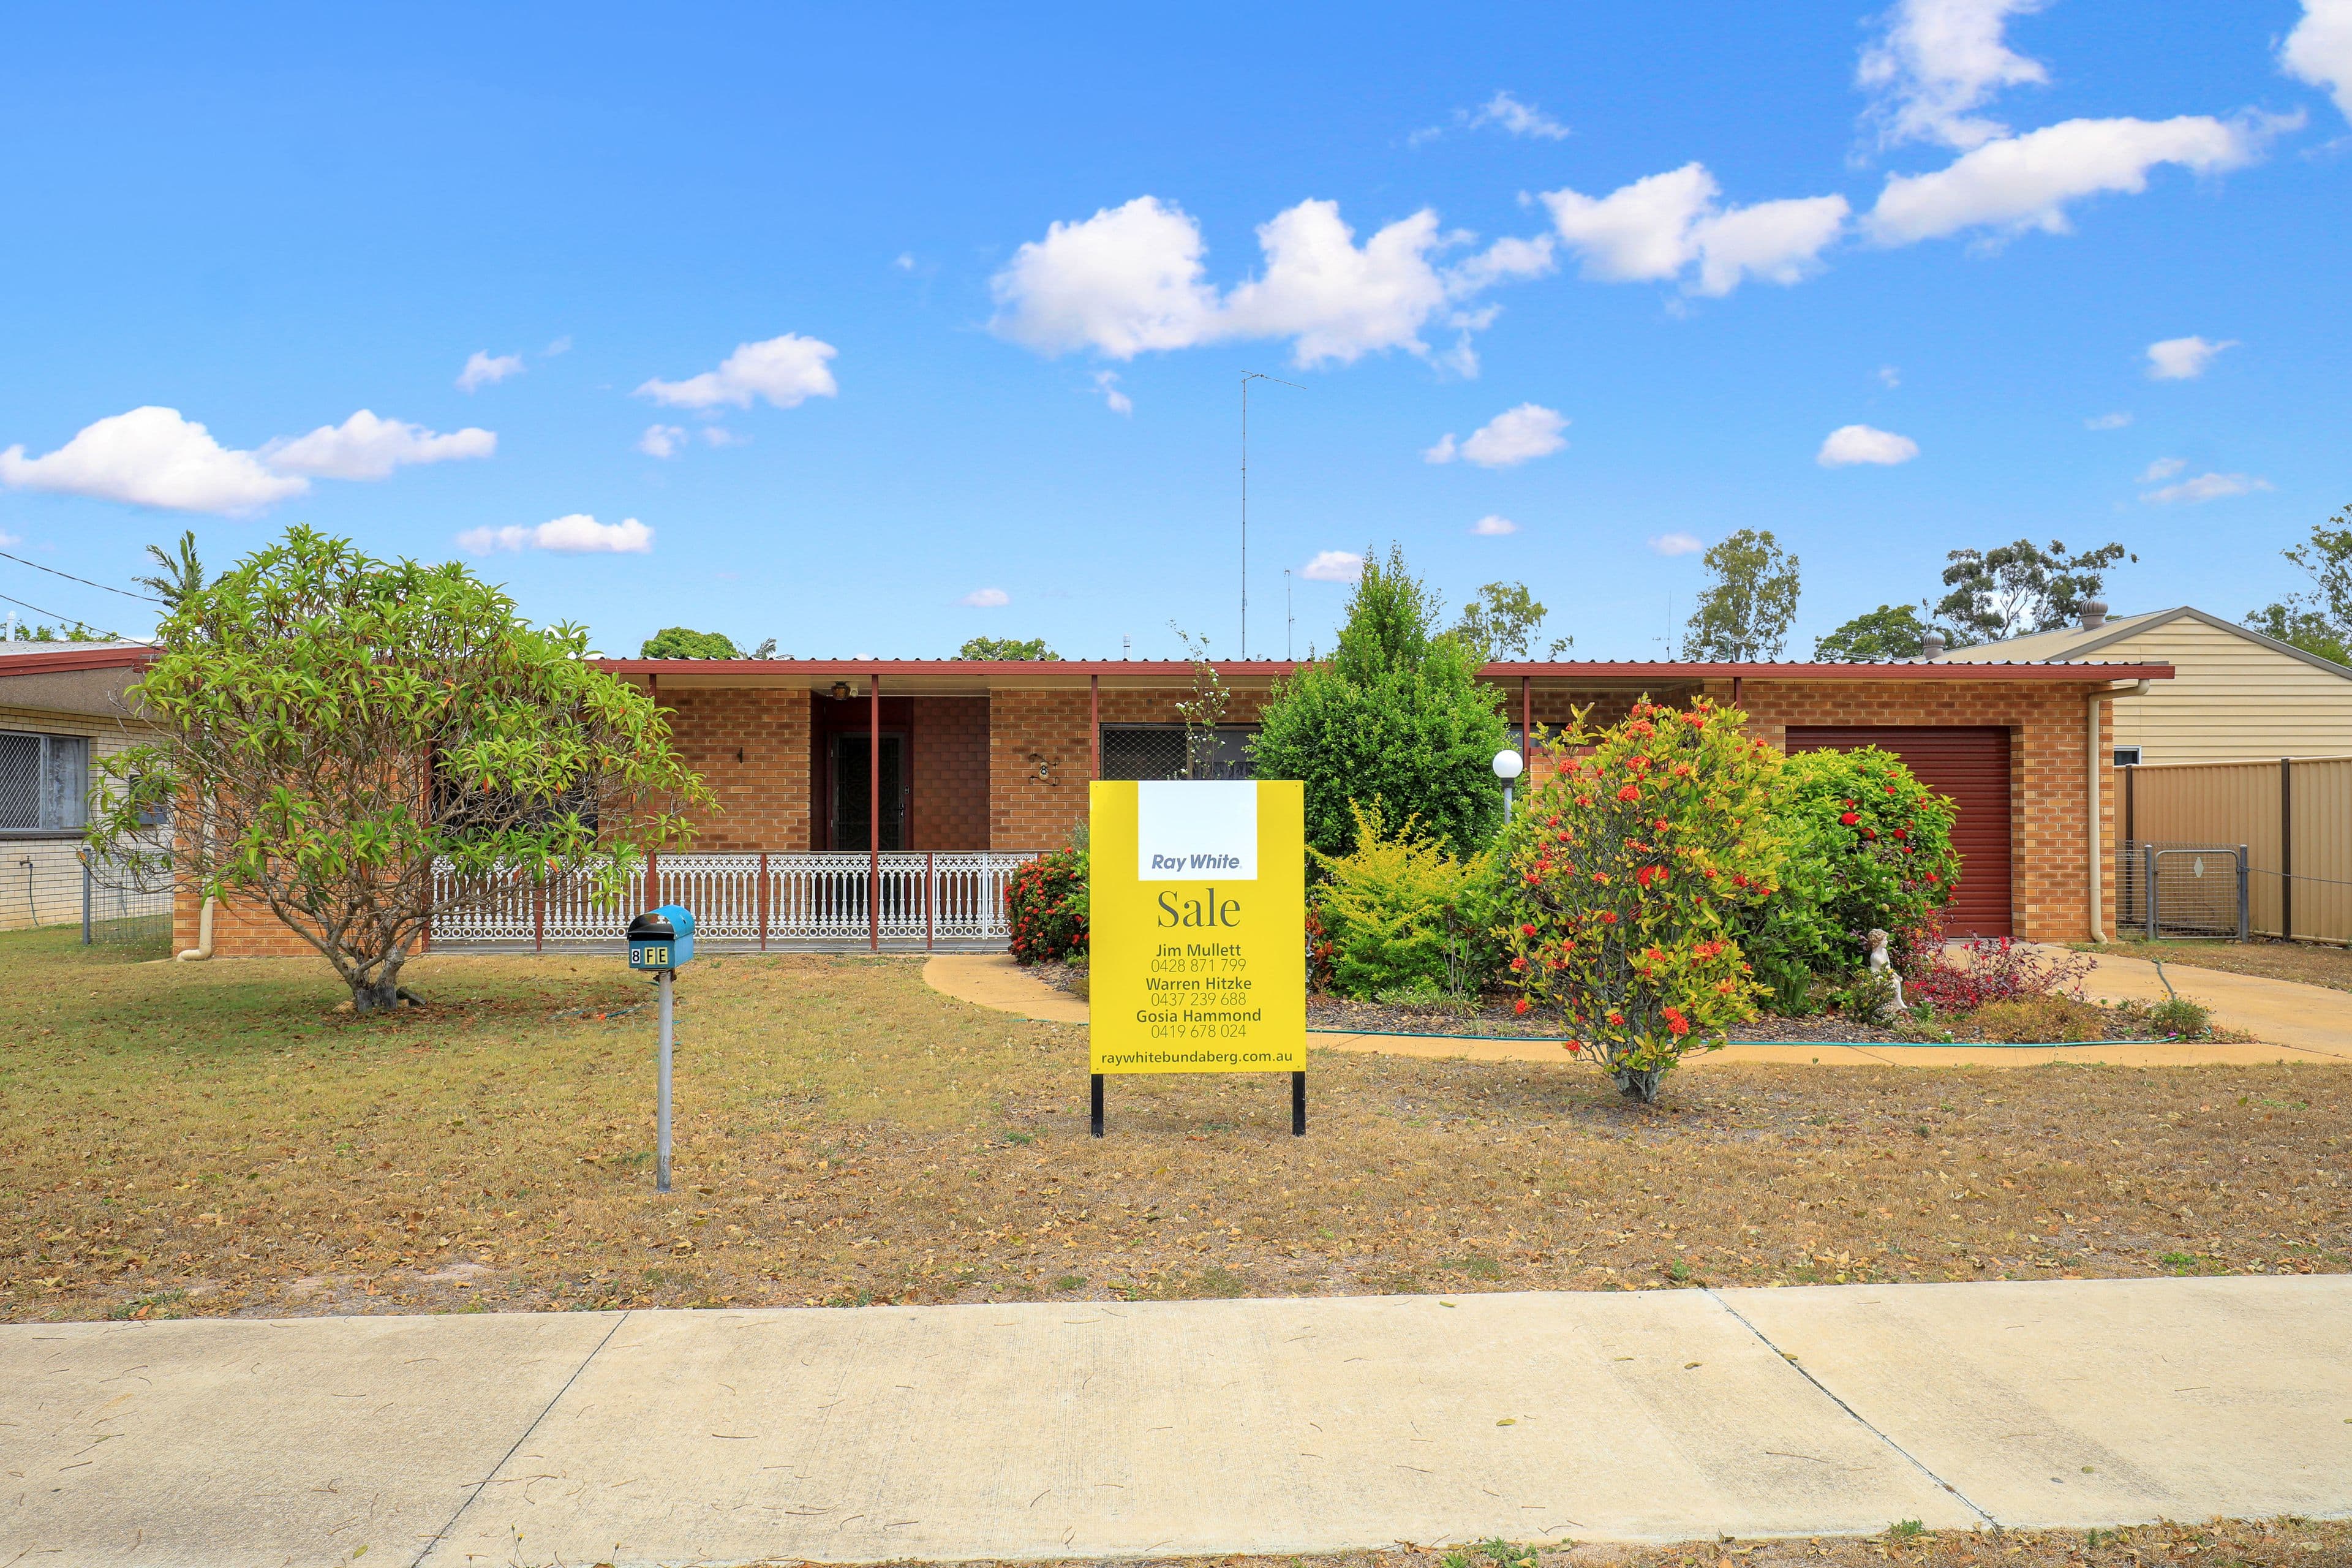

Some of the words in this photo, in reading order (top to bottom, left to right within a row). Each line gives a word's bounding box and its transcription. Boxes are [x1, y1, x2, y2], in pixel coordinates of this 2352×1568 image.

[1152, 854, 1187, 872] Ray
[1190, 854, 1240, 870] White
[1158, 888, 1241, 928] Sale
[633, 951, 639, 962] 8
[1156, 943, 1182, 957] Jim
[1187, 943, 1242, 957] Mullett
[1151, 959, 1186, 973] 0428
[1191, 959, 1216, 973] 871
[1221, 959, 1246, 973] 799
[1146, 977, 1200, 990] Warren
[1206, 977, 1252, 990] Hitzke
[1151, 993, 1185, 1006] 0437
[1190, 993, 1216, 1006] 239
[1221, 993, 1246, 1006] 688
[1136, 1009, 1178, 1023] Gosia
[1183, 1008, 1261, 1022] Hammond
[1151, 1025, 1186, 1038] 0419
[1191, 1025, 1216, 1038] 678
[1221, 1025, 1246, 1038] 024
[1101, 1050, 1293, 1066] raywhitebundaberg.com.au
